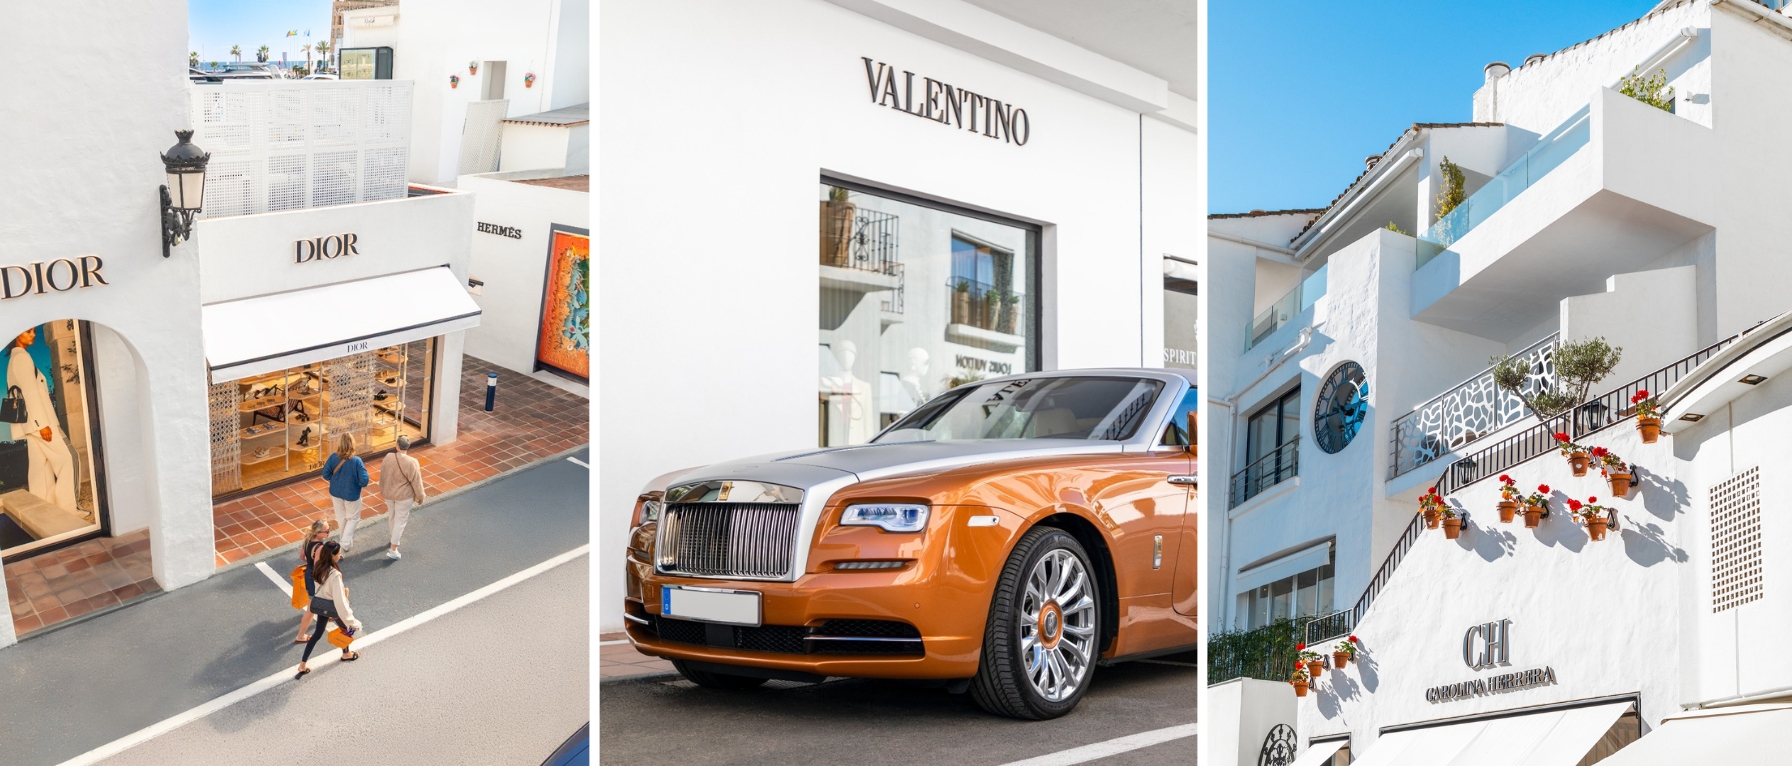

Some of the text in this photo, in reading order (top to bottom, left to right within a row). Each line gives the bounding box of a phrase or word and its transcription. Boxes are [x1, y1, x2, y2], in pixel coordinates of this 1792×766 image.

[861, 56, 1030, 146] VALENTINO
[477, 221, 522, 239] HERMÈS
[295, 233, 359, 264] DIOR
[0, 255, 109, 300] DIOR
[347, 341, 368, 353] DIOR
[1164, 347, 1197, 365] SPIRIT
[1463, 618, 1509, 669] CH
[1425, 666, 1555, 703] CAROLINA HERRERA
